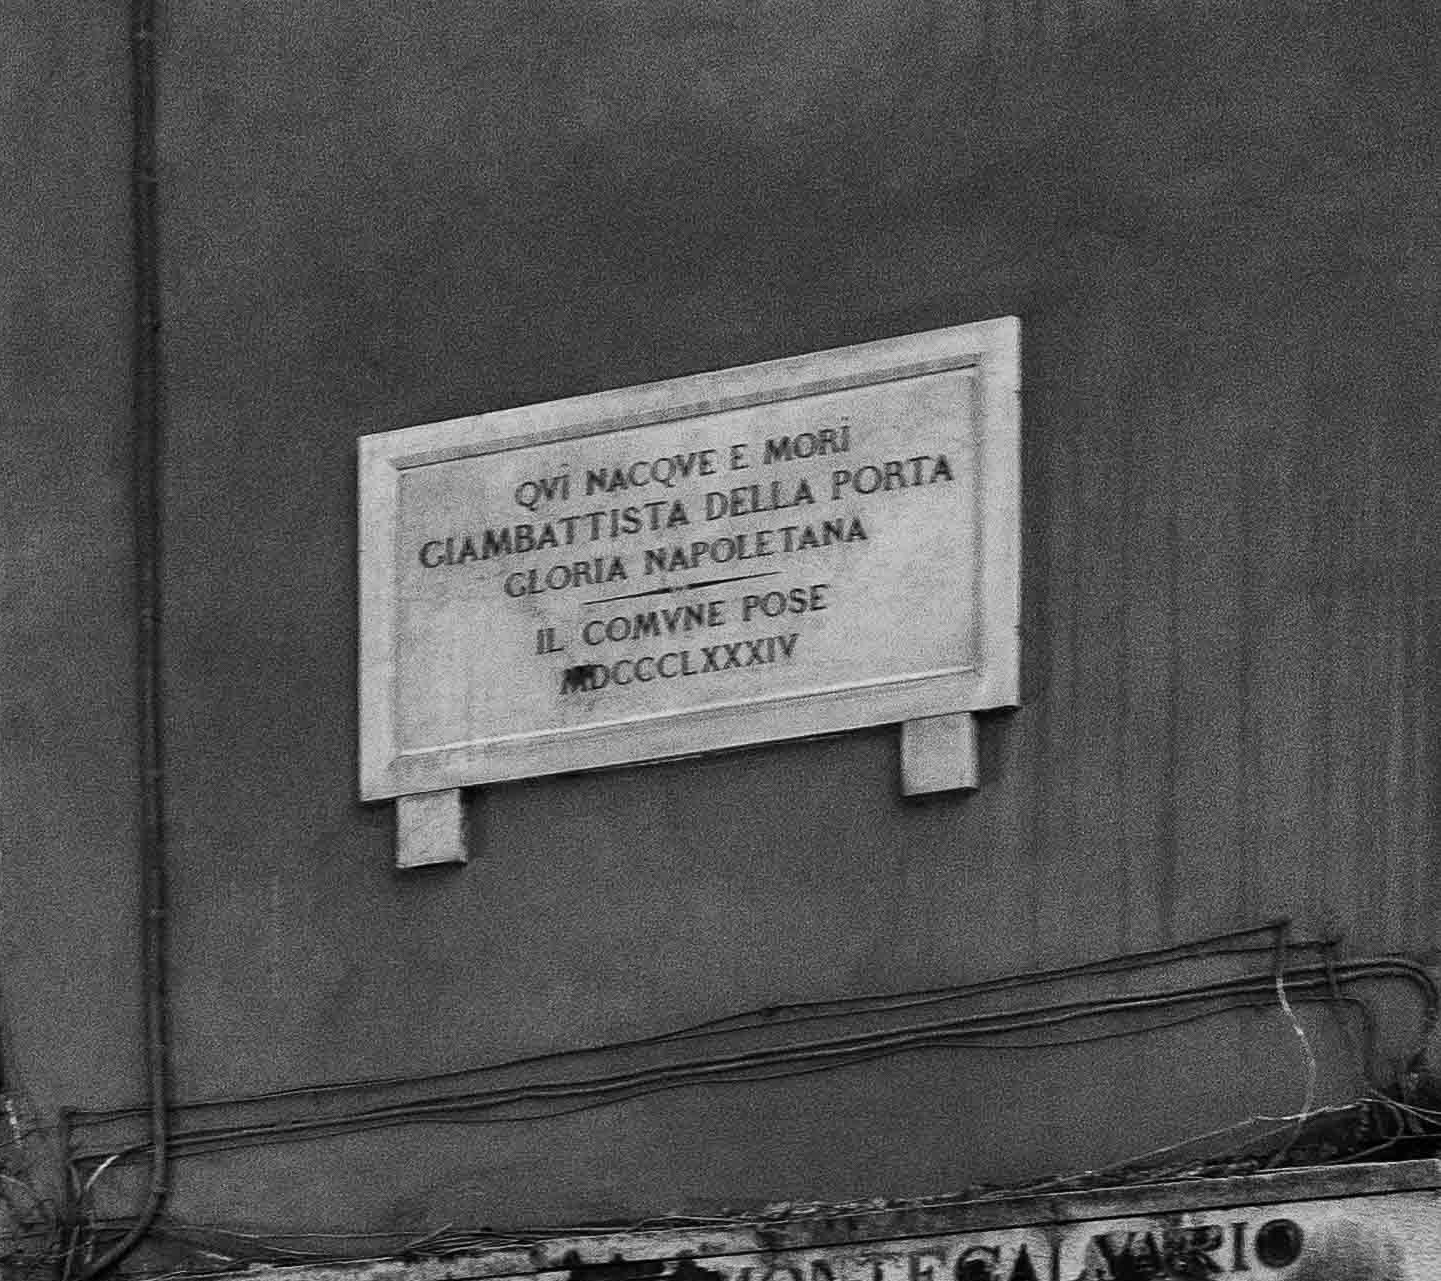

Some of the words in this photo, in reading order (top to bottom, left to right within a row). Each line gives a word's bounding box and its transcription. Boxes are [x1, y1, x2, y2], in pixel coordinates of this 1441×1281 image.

[584, 449, 717, 497] NACQVE
[729, 443, 750, 471] E
[704, 479, 817, 521] DELLA
[831, 454, 956, 501] PORTA
[503, 556, 628, 598] GLORIA
[643, 517, 869, 576] NAPOLETANA
[535, 627, 565, 656] IL
[581, 600, 726, 647] COMVNE
[741, 584, 828, 622] POSE
